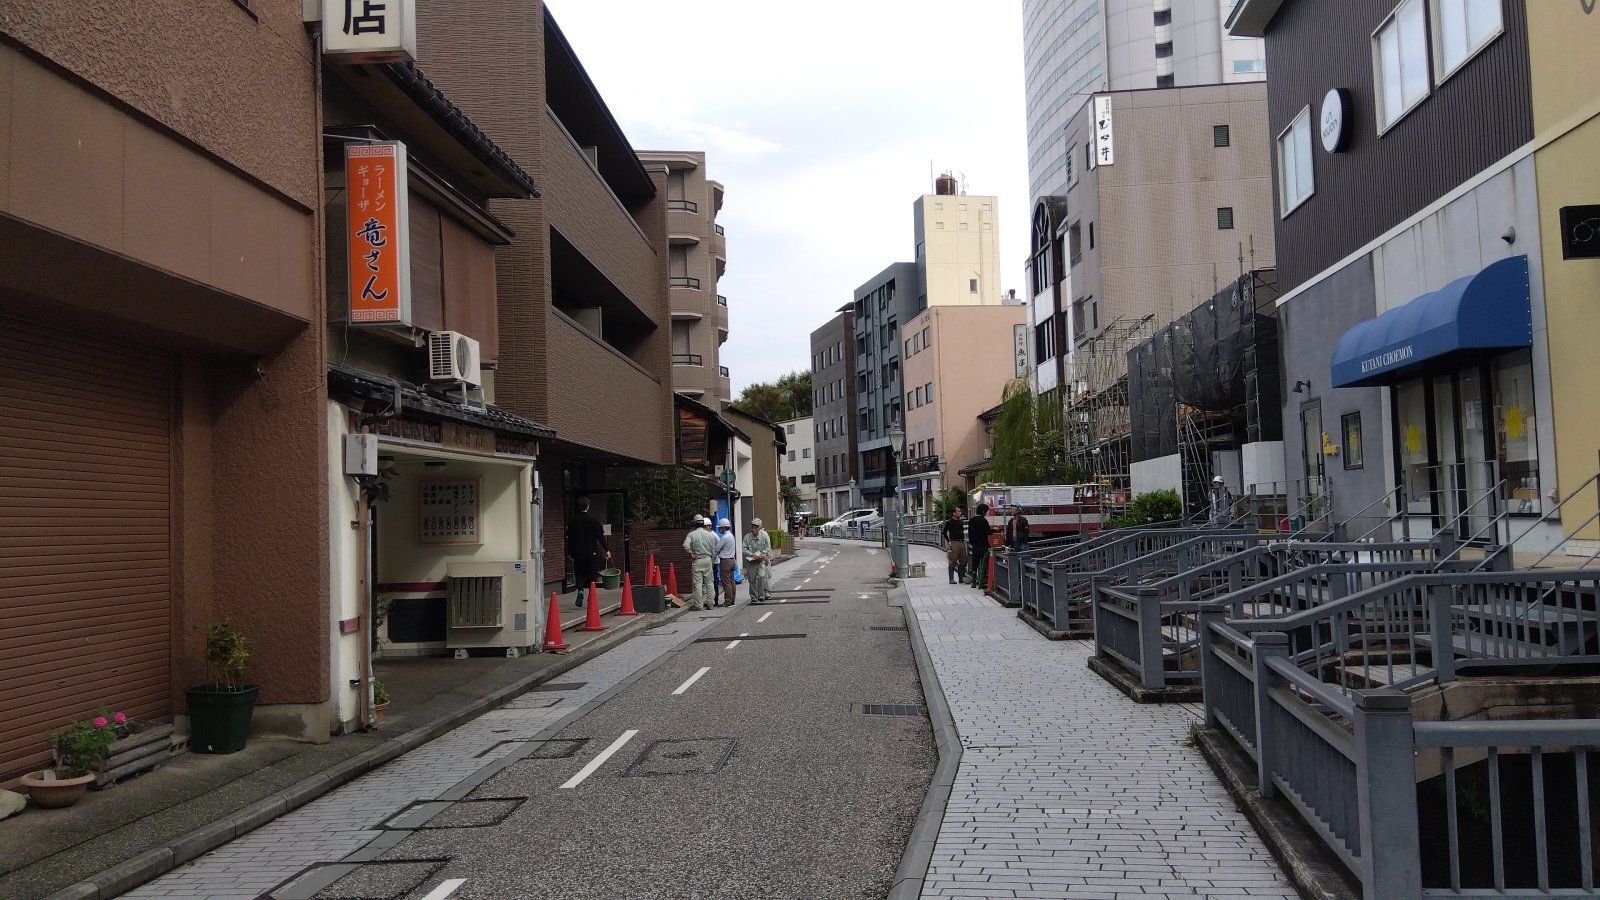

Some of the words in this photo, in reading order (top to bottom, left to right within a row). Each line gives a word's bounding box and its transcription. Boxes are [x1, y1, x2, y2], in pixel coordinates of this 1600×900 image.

[343, 0, 386, 35] 店
[357, 165, 370, 213] ギョーザ
[374, 165, 386, 212] ラーメン
[356, 217, 388, 302] 竜さん
[1361, 355, 1383, 373] KUTANI
[1383, 344, 1413, 366] CHOEMON
